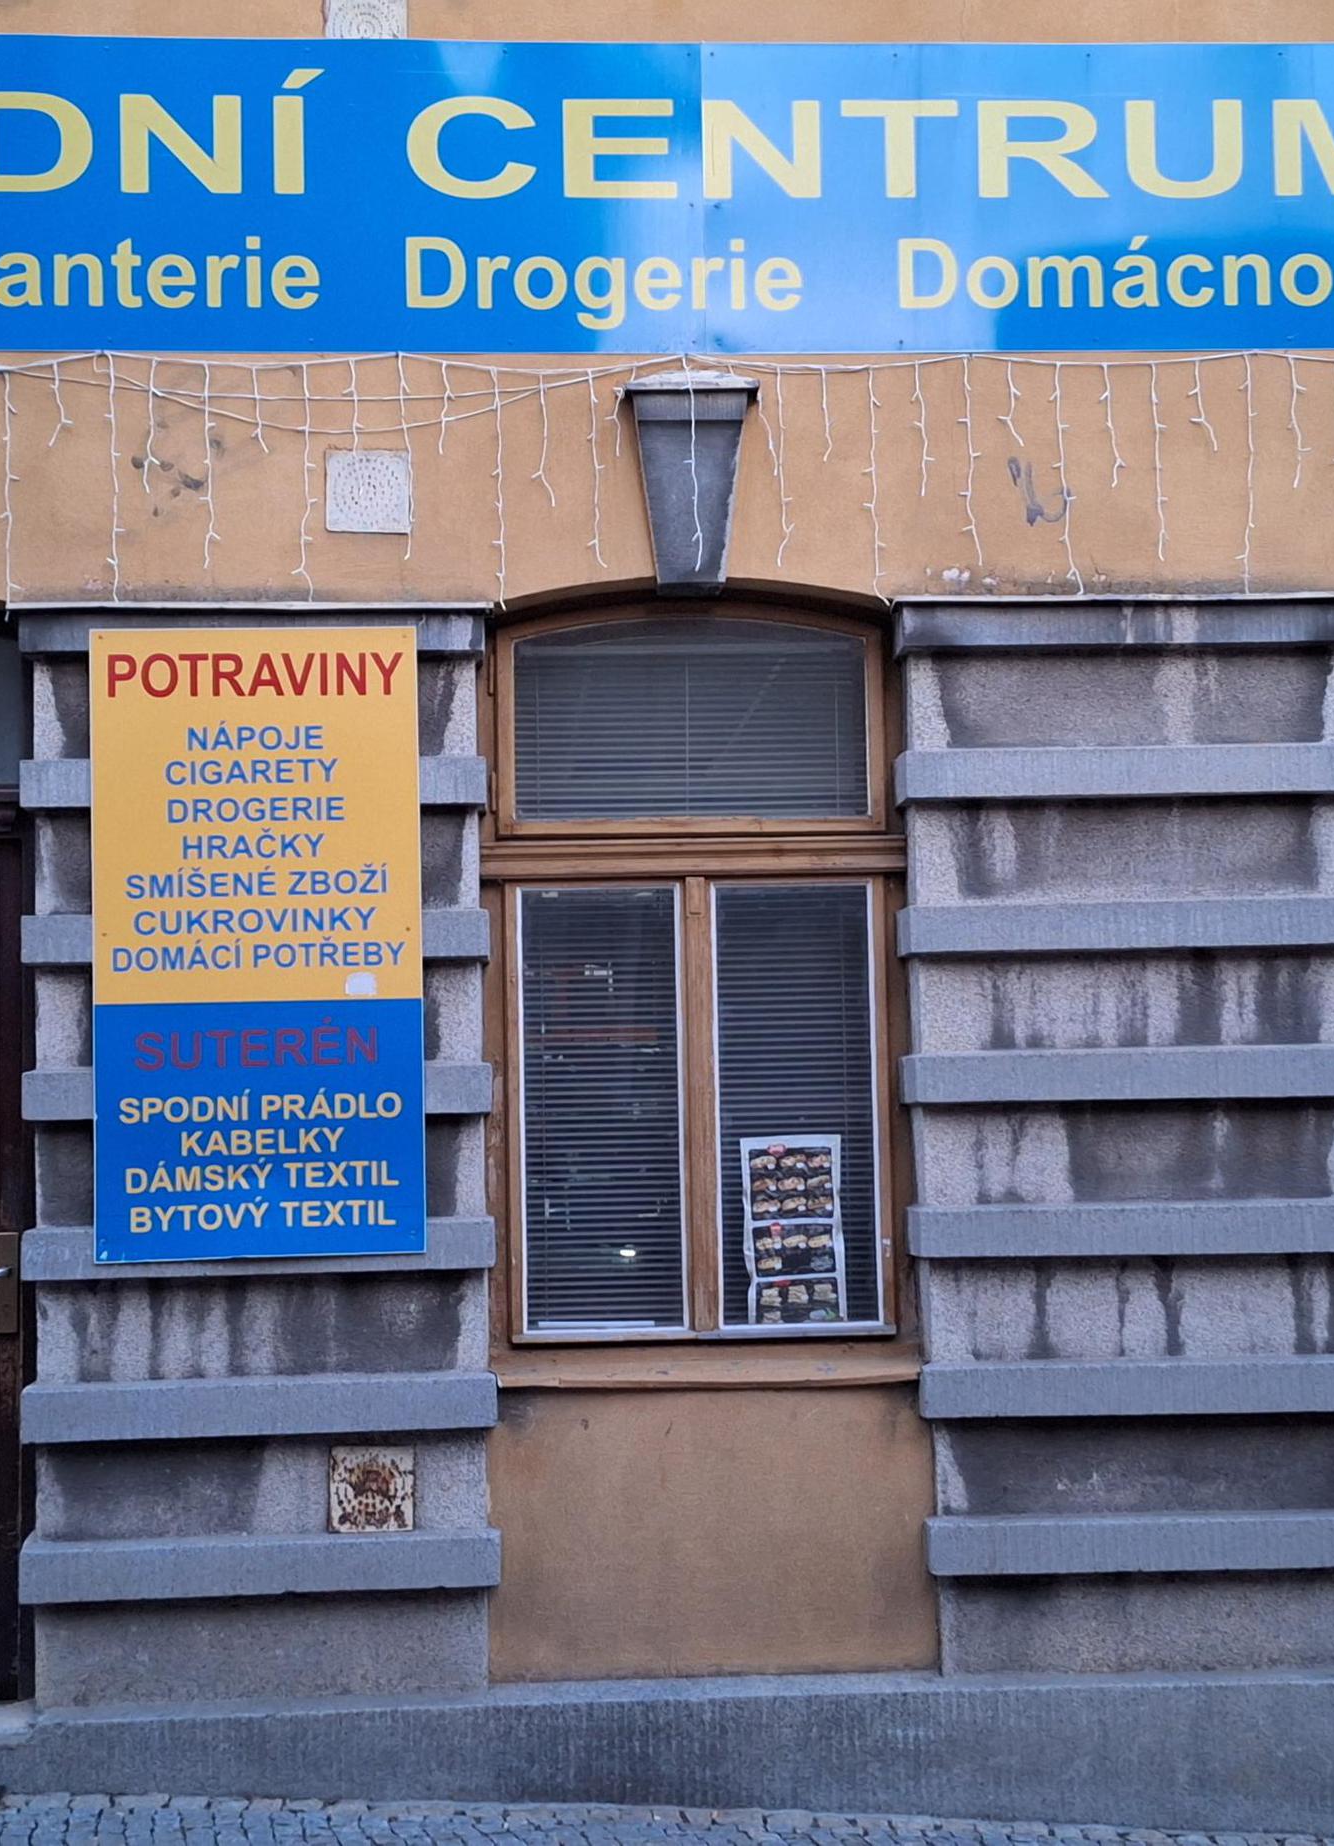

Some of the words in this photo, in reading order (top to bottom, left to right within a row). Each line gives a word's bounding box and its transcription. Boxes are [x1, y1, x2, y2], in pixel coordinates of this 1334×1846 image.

[404, 236, 803, 330] Drogerie
[107, 652, 404, 698] POTRAVINY
[187, 721, 324, 751] NÁPOJE
[165, 758, 338, 786] CIGARETY
[167, 796, 345, 824] DROGERIE
[181, 828, 325, 860] HRAČKY
[125, 865, 277, 899] SMÍŠENÉ
[287, 862, 388, 897] ZBOŽÍ
[133, 907, 377, 936] CUKROVINKY
[112, 940, 242, 973] DOMÁCÍ
[252, 936, 405, 969] POTŘEBY
[134, 1017, 378, 1071] SUTERÉN
[119, 1088, 251, 1124] SPODNÍ
[260, 1087, 403, 1120] PRÁDLO
[180, 1126, 345, 1157] KABELKY
[125, 1157, 273, 1194] DÁMSKÝ
[283, 1160, 399, 1189] TEXTIL
[130, 1196, 269, 1233] BYTOVÝ
[279, 1200, 397, 1227] TEXTIL
